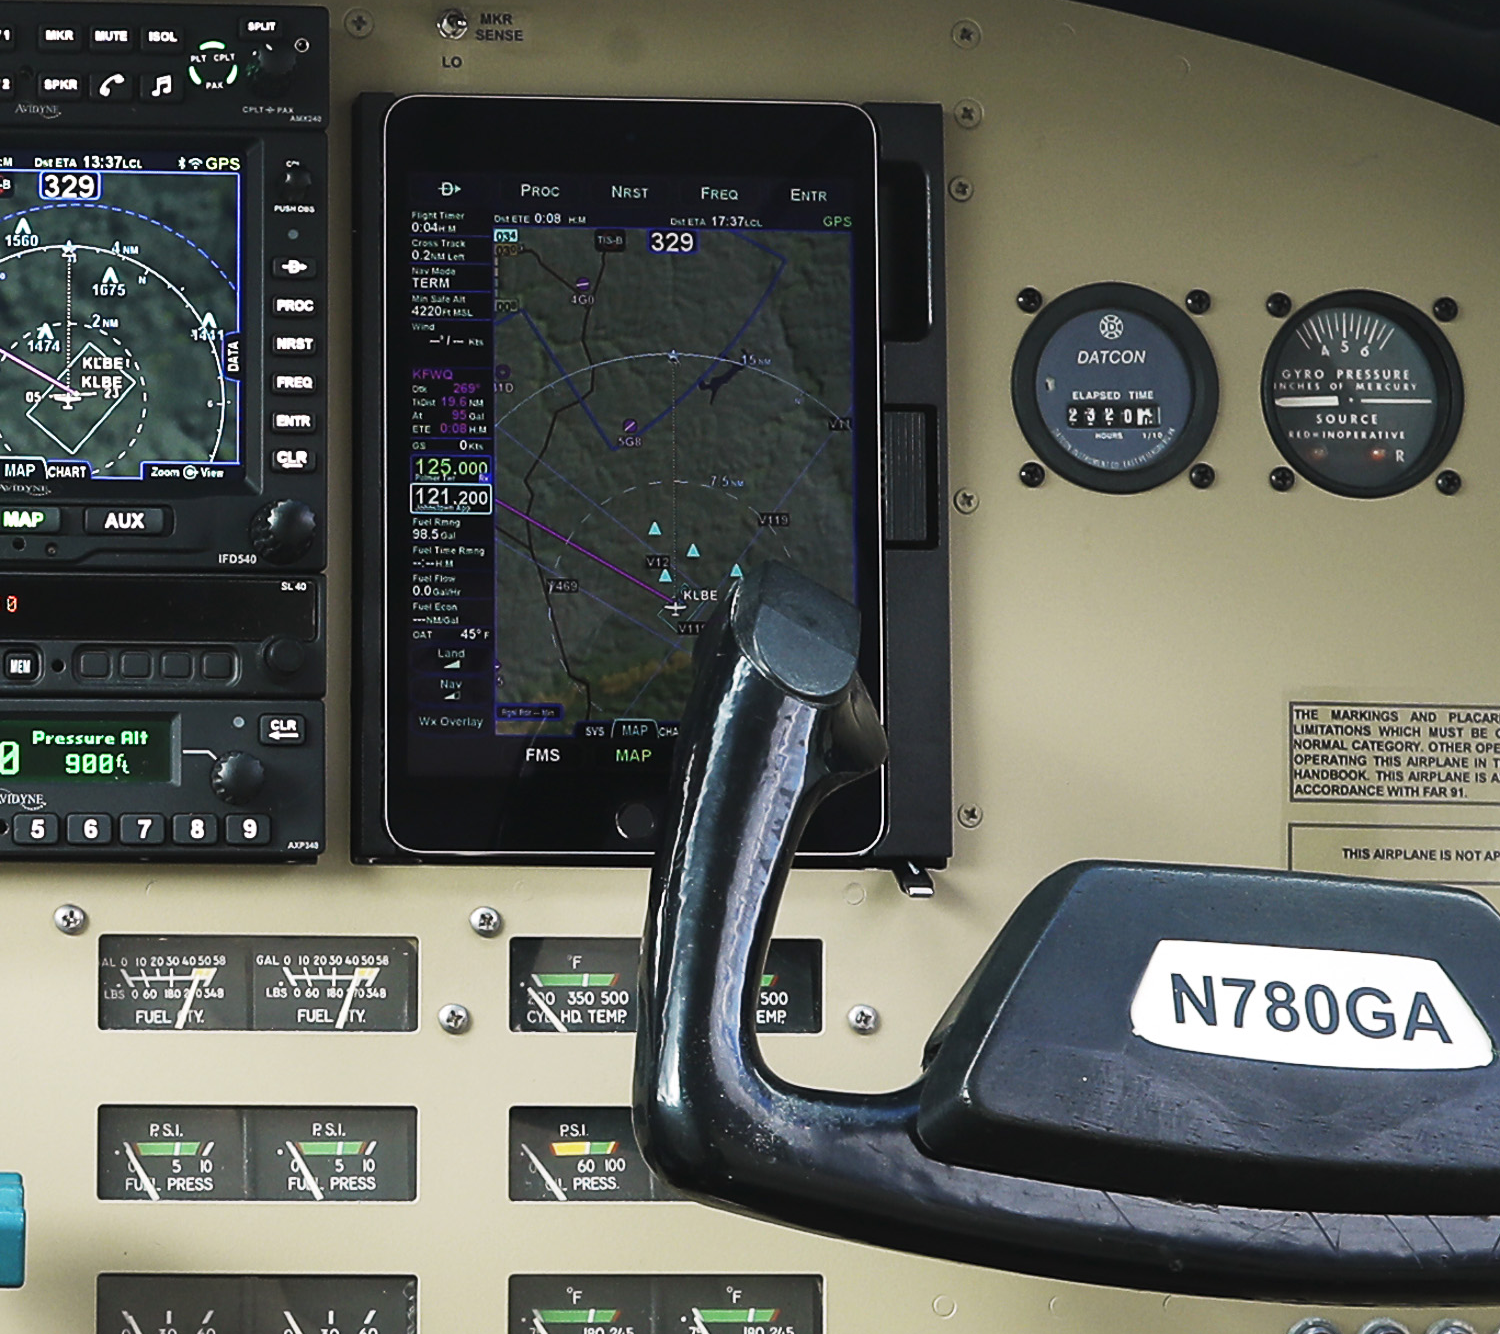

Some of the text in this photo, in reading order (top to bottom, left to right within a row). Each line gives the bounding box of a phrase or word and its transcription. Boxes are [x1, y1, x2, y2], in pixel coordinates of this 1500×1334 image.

[480, 14, 512, 25] MKR
[46, 31, 127, 42] MKR MUTE
[476, 30, 523, 41] SENSE
[442, 56, 462, 68] LO
[206, 156, 240, 170] GPS
[44, 175, 95, 197] 329
[651, 232, 693, 251] 329
[277, 298, 313, 313] PROC
[277, 337, 313, 350] NRST
[1078, 350, 1146, 364] DATCON
[1282, 369, 1410, 380] GYRO PRESSURE
[277, 375, 313, 389] FREQ
[277, 414, 311, 427] ENTR
[1317, 414, 1378, 424] SOURCE
[4, 463, 35, 478] MAP
[48, 466, 86, 479] CHART
[3, 511, 42, 527] MAP
[105, 513, 144, 529] AUX
[219, 553, 256, 564] IFD540
[1295, 710, 1318, 720] THE
[1331, 710, 1398, 721] MARKINGS
[1410, 712, 1436, 722] AND
[526, 749, 560, 762] FMS
[616, 749, 651, 762] MAP
[1295, 784, 1468, 798] ACCORDANCE WITH FAR 91.
[1170, 973, 1452, 1044] N780GA
[168, 1177, 213, 1190] PRESS
